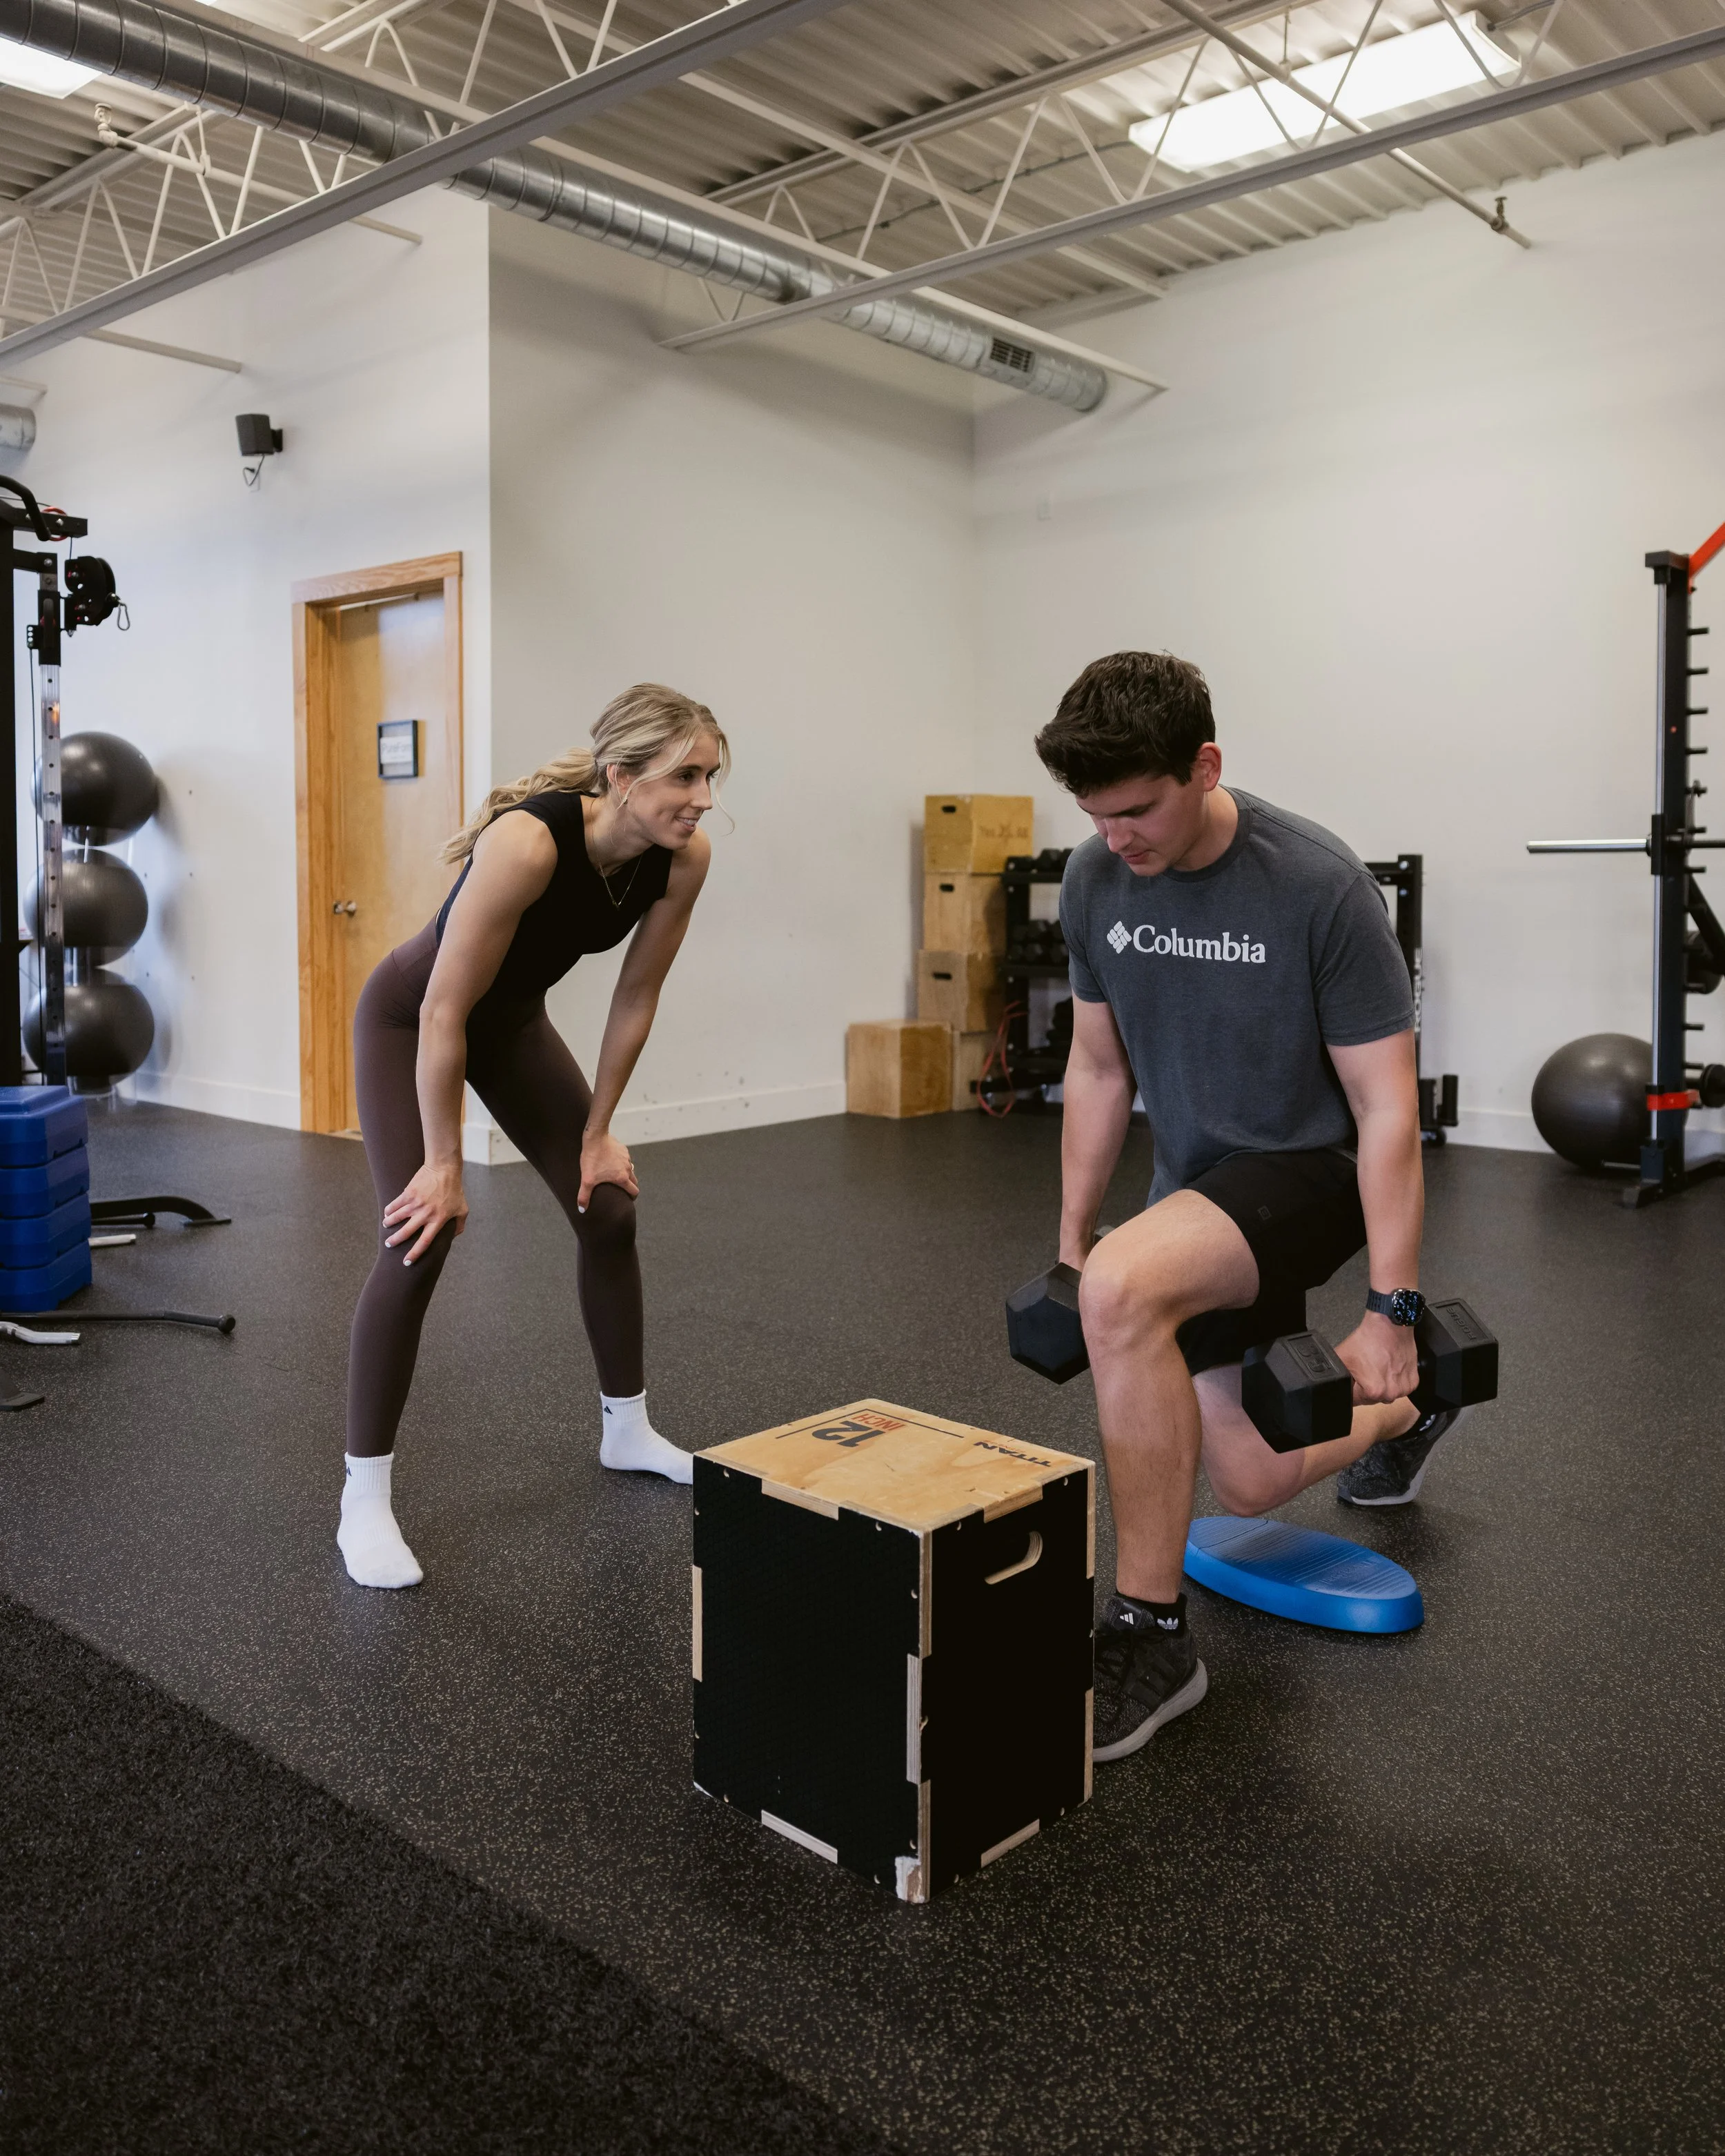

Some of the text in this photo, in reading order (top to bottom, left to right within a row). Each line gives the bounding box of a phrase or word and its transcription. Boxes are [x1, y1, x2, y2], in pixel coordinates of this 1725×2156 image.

[1133, 924, 1266, 963] Columbia
[1414, 947, 1422, 1032] ROGUE
[1296, 1344, 1332, 1373] 35
[811, 1421, 886, 1447] 12
[851, 1414, 906, 1431] INCH
[974, 1441, 1052, 1467] TITAN
